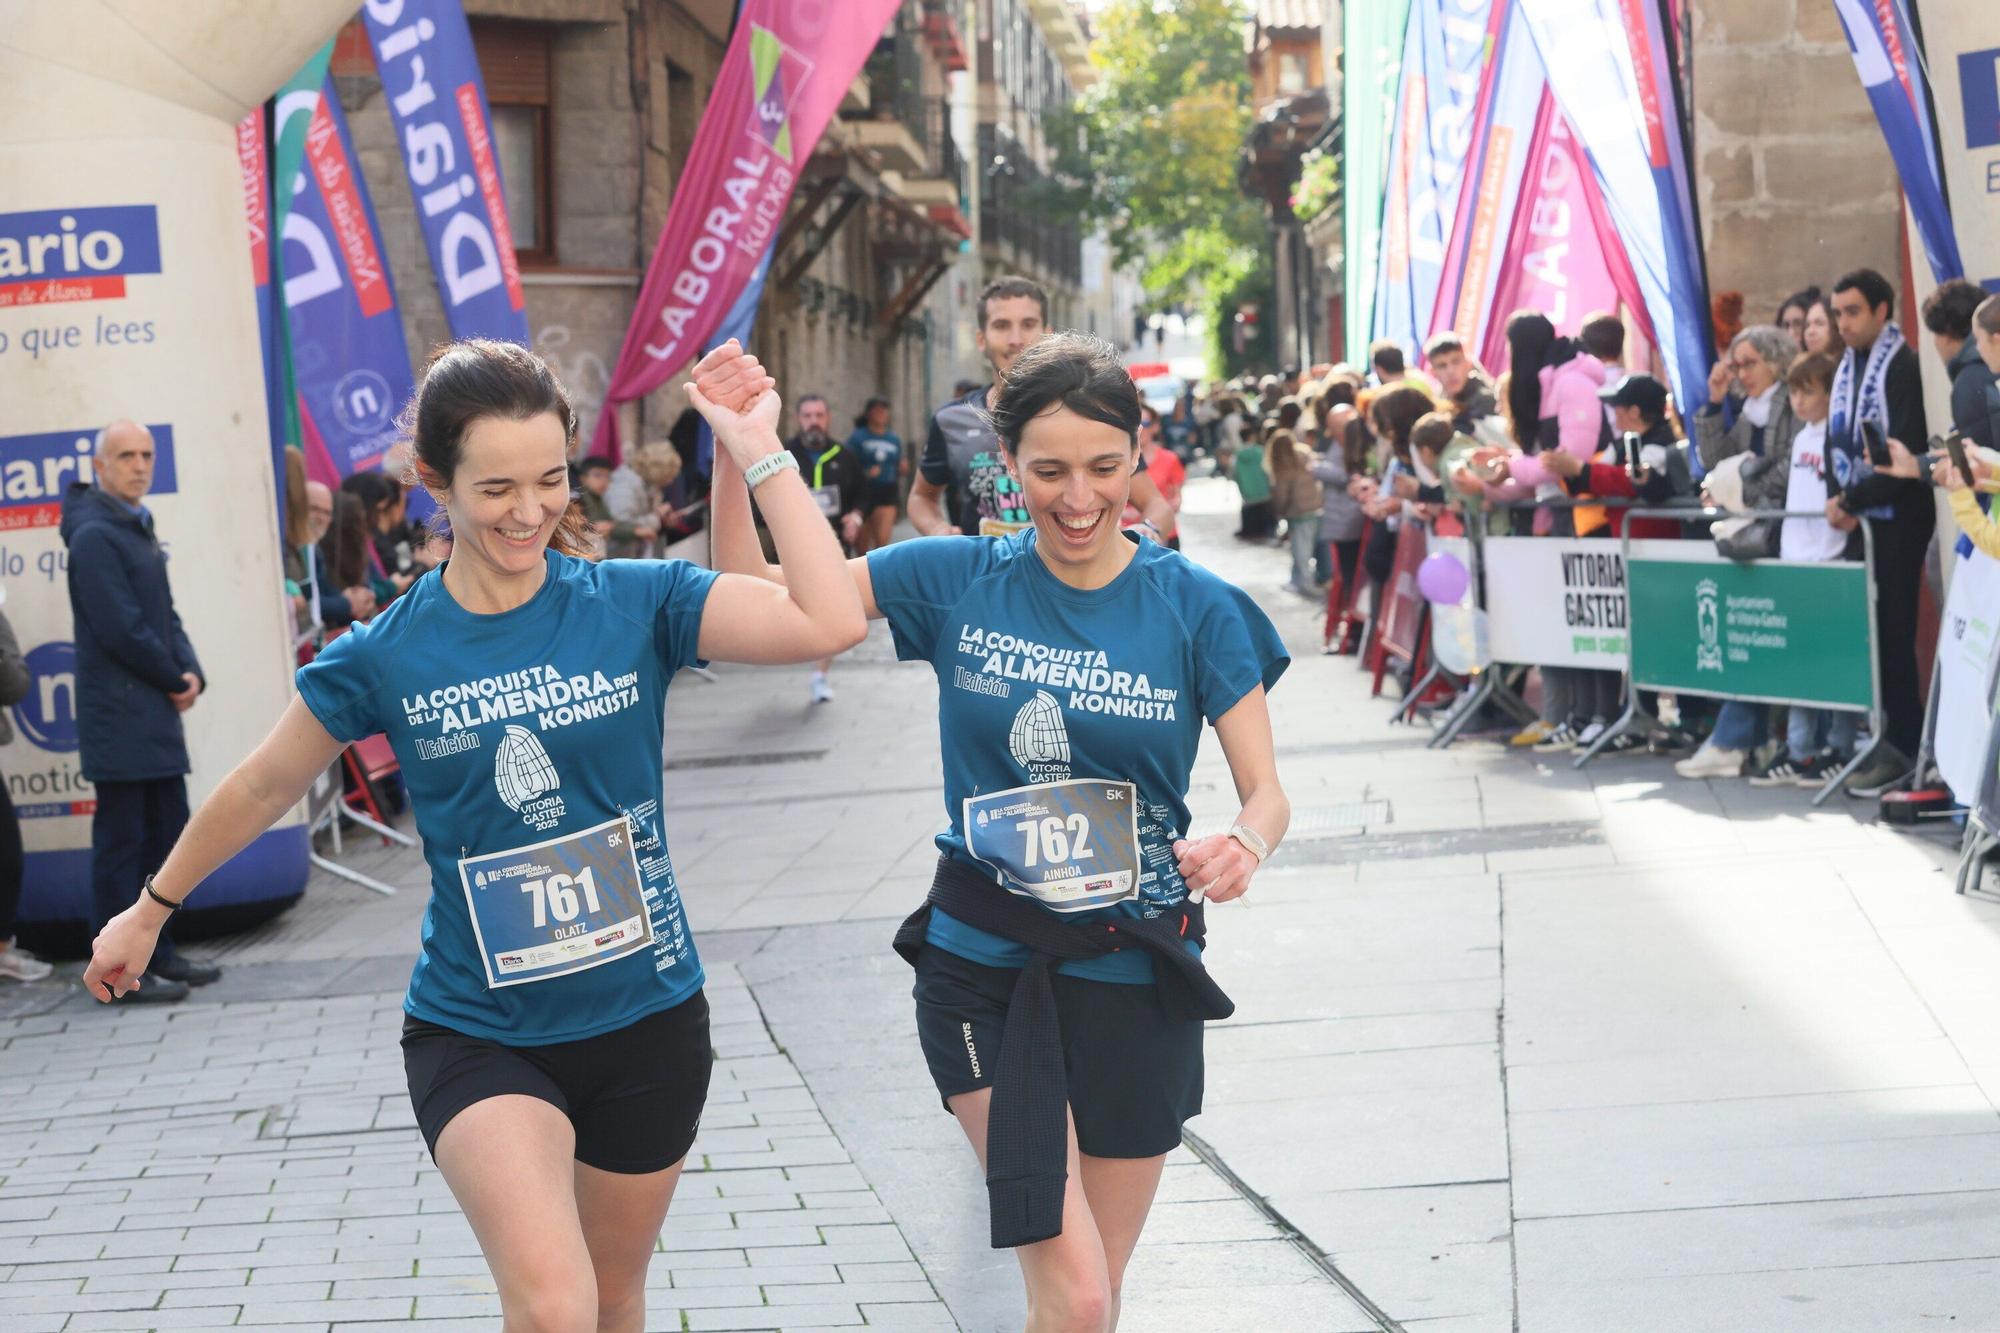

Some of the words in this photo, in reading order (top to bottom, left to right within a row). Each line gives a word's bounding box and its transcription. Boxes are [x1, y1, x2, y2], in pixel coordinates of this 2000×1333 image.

[737, 165, 793, 257] kutxa
[643, 154, 769, 361] LABORAL
[21, 326, 81, 360] que
[96, 316, 155, 345] lees
[1561, 552, 1625, 588] VITORIA
[960, 624, 984, 645] LA
[985, 631, 1109, 669] CONQUISTA
[958, 641, 973, 653] DE
[974, 645, 988, 658] LA
[982, 651, 1152, 700] ALMENDRA
[1153, 688, 1178, 702] REN
[963, 670, 1010, 698] Edición
[402, 693, 429, 715] LA
[429, 664, 562, 709] CONQUISTA
[408, 714, 424, 726] DE
[425, 709, 441, 722] LA
[442, 670, 615, 734] ALMENDRA
[613, 671, 638, 690] REN
[538, 686, 640, 731] KONKISTA
[1069, 691, 1176, 722] KONKISTA
[428, 730, 481, 759] Edición
[1028, 763, 1071, 773] VITORIA
[1029, 773, 1072, 783] GASTEIZ
[520, 795, 564, 814] VITORIA
[1106, 788, 1124, 801] 5K
[523, 806, 567, 825] GASTEIZ
[536, 819, 559, 832] 2025
[607, 831, 623, 848] 5K
[1016, 813, 1094, 868] 762
[1044, 864, 1083, 882] AINHOA
[520, 866, 601, 929] 761
[555, 922, 588, 941] OLATZ
[962, 1022, 982, 1079] SALOMON
